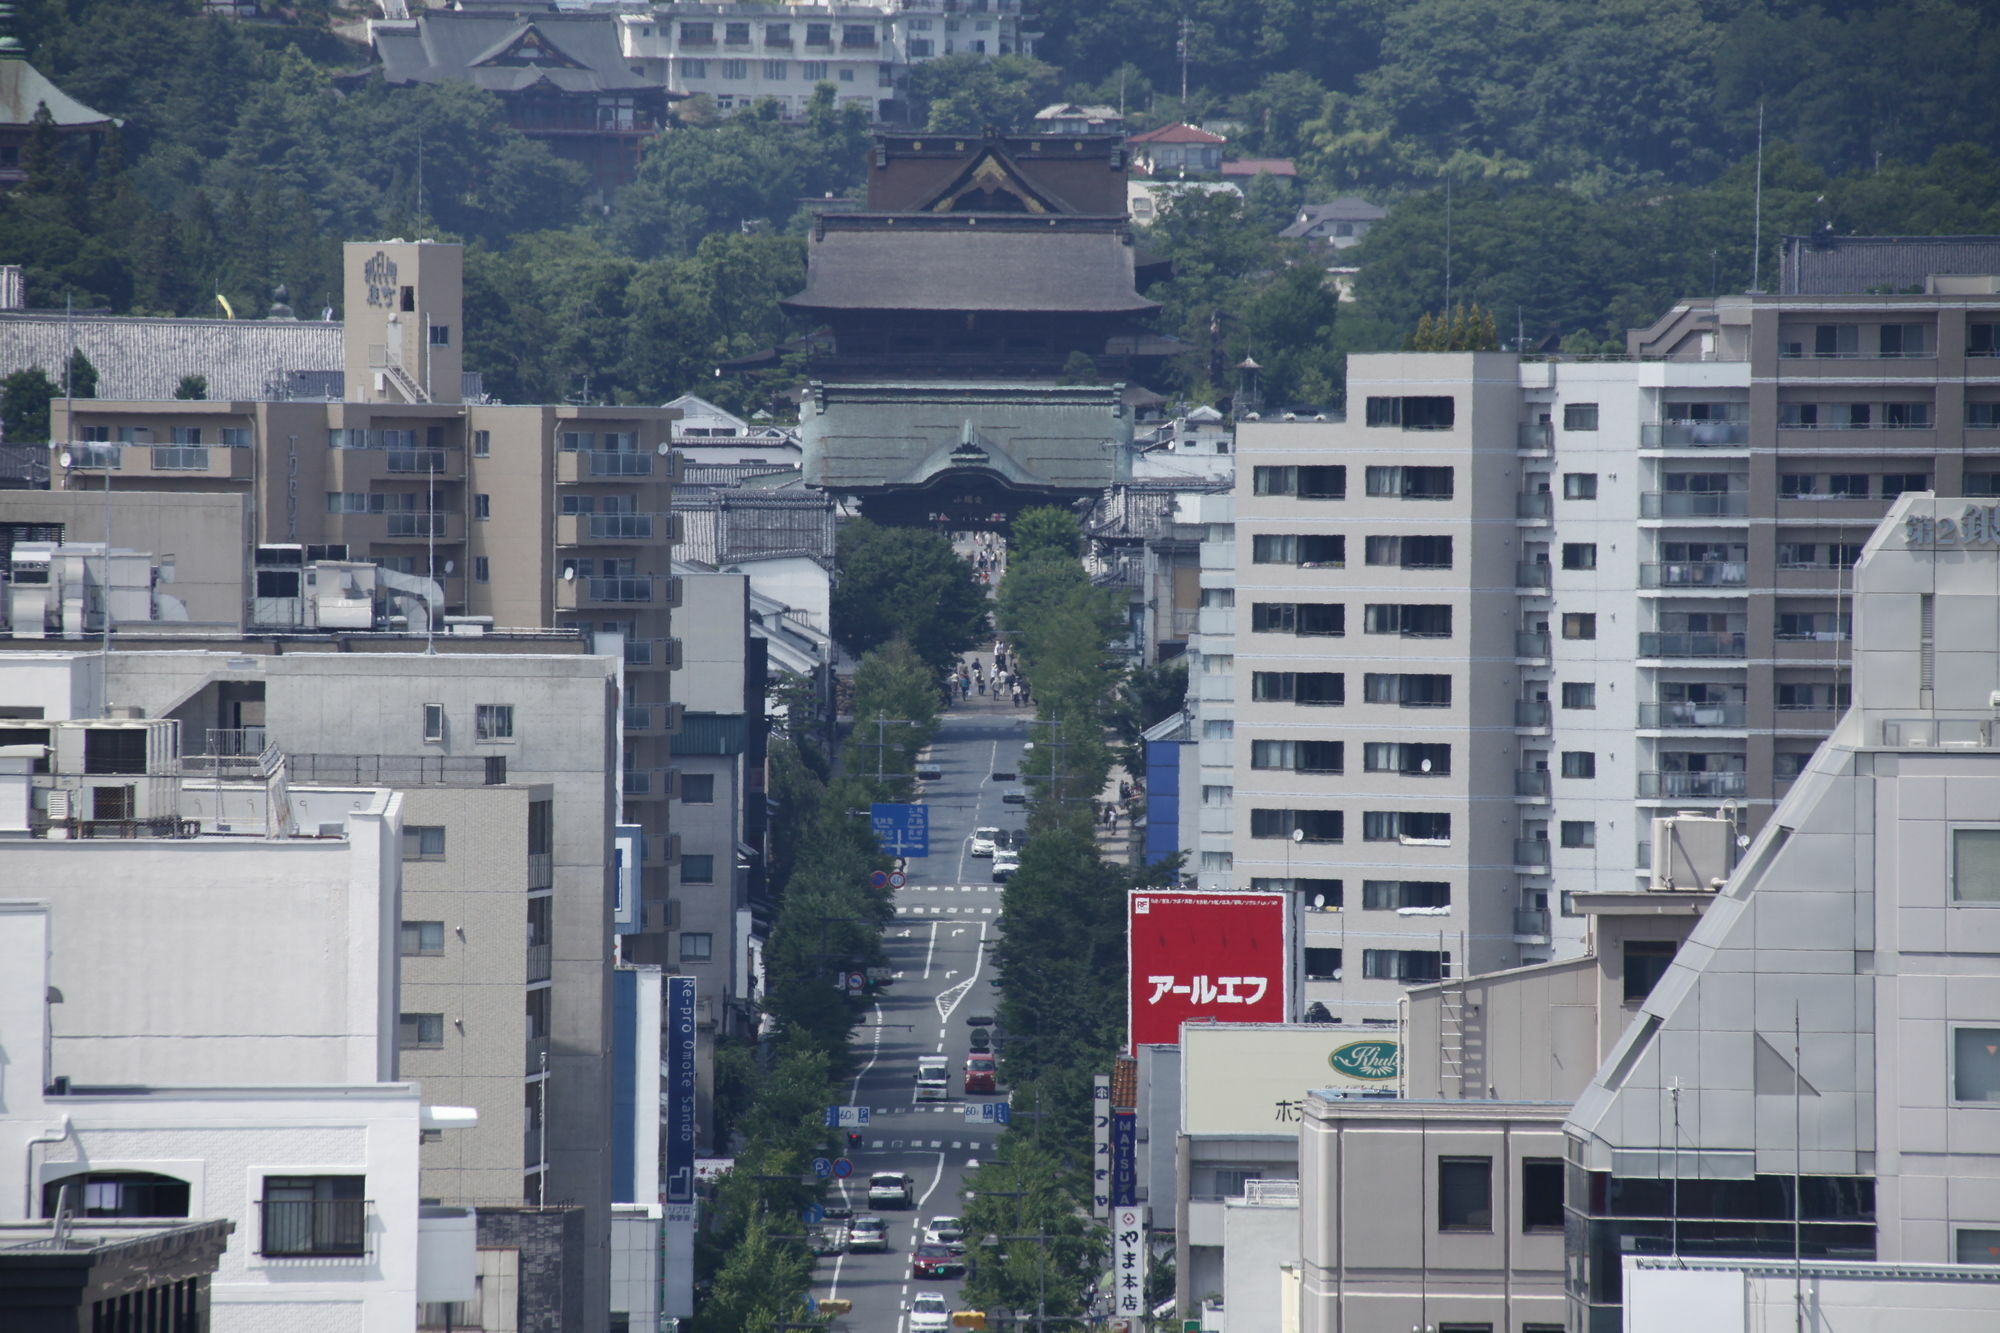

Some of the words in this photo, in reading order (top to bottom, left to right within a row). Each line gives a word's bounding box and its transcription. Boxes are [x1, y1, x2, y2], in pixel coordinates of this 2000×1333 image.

[680, 980, 694, 1033] Re-pro
[1148, 975, 1268, 1005] アールエフ
[681, 1040, 694, 1088] Omote
[680, 1096, 693, 1141] Sando
[1119, 1230, 1139, 1312] やま本店
